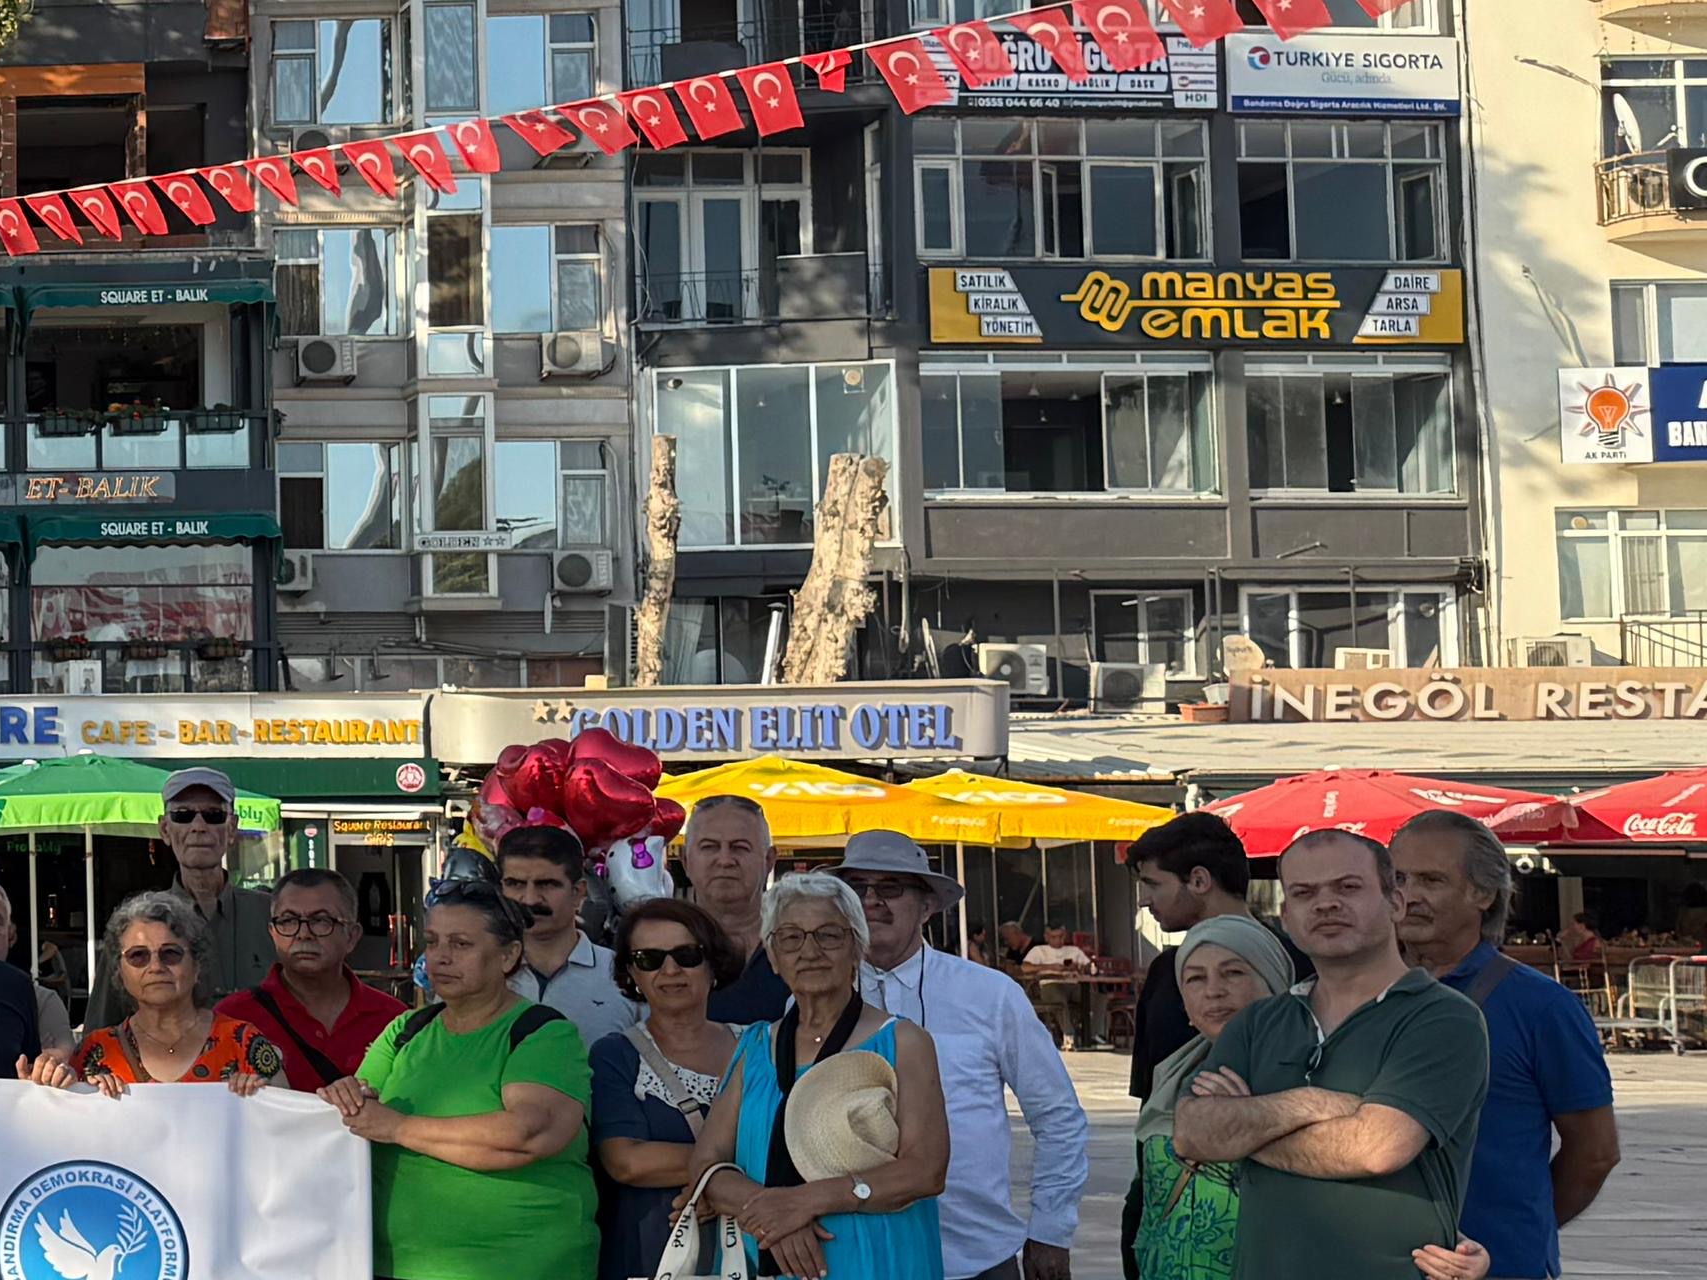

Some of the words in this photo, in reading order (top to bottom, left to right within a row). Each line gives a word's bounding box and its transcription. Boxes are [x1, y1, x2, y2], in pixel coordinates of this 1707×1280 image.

[1027, 77, 1060, 89] KASKO
[1129, 78, 1155, 89] DASK
[1185, 93, 1207, 103] HDI
[960, 273, 1007, 289] SATILIK
[1394, 273, 1431, 290] DAİRE
[100, 290, 149, 305] SQUARE
[151, 289, 165, 304] ET
[175, 288, 209, 303] BALIK
[973, 295, 1020, 311] KİRALIK
[1386, 296, 1420, 311] ARSA
[984, 316, 1035, 335] YÖNETİM
[1372, 318, 1413, 334] TARLA
[1584, 451, 1599, 460] AK
[1600, 449, 1627, 460] PARTİ
[75, 475, 161, 500] BALIK
[100, 521, 149, 537] SQUARE
[151, 521, 165, 536] ET
[175, 520, 209, 536] BALIK
[418, 537, 480, 549] GOLDEN
[1250, 673, 1501, 720] İNEGÖL
[79, 719, 153, 746] CAFE
[177, 719, 237, 745] BAR
[251, 717, 423, 747] RESTAURANT
[750, 703, 842, 750] ELİT
[849, 701, 961, 751] OTEL
[1624, 811, 1698, 838] Coca-Cola
[29, 1169, 135, 1201] DEMOKRASİ
